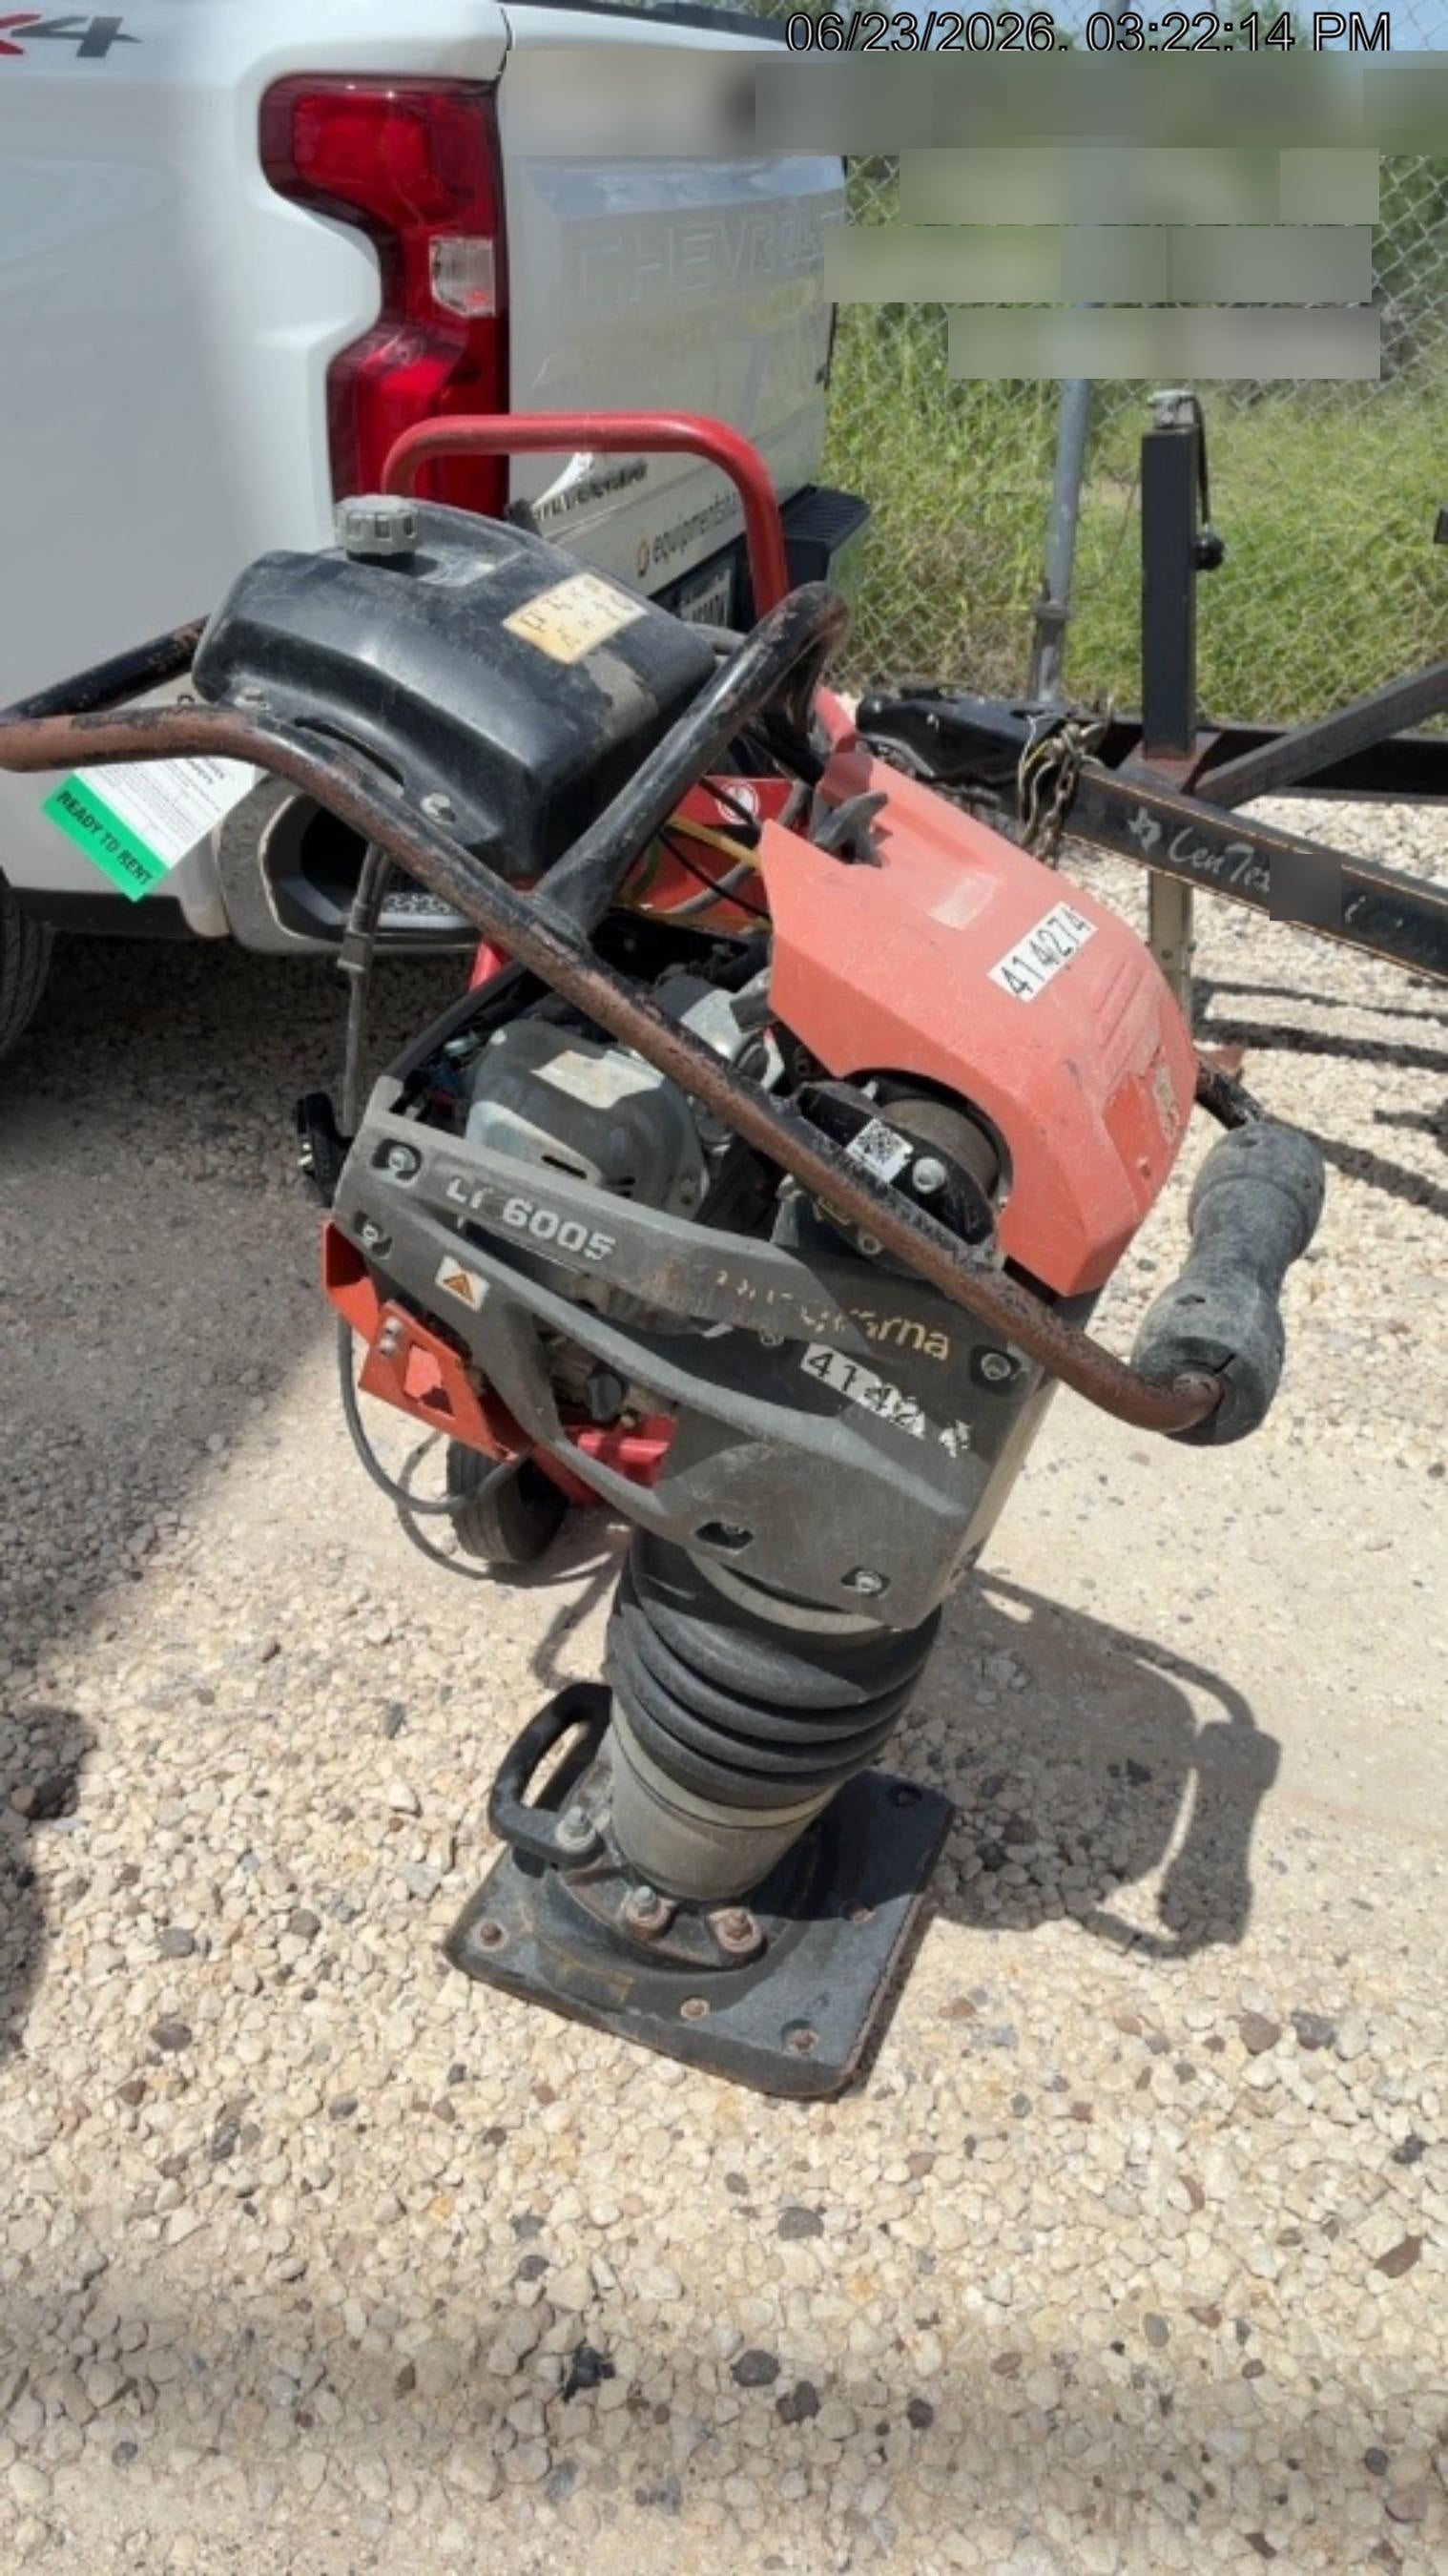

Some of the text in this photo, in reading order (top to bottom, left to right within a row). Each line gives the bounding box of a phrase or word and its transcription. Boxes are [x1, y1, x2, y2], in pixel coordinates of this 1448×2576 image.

[56, 790, 154, 885] READY TO RENT
[1001, 906, 1092, 994] 414274
[503, 1197, 617, 1261] 6005
